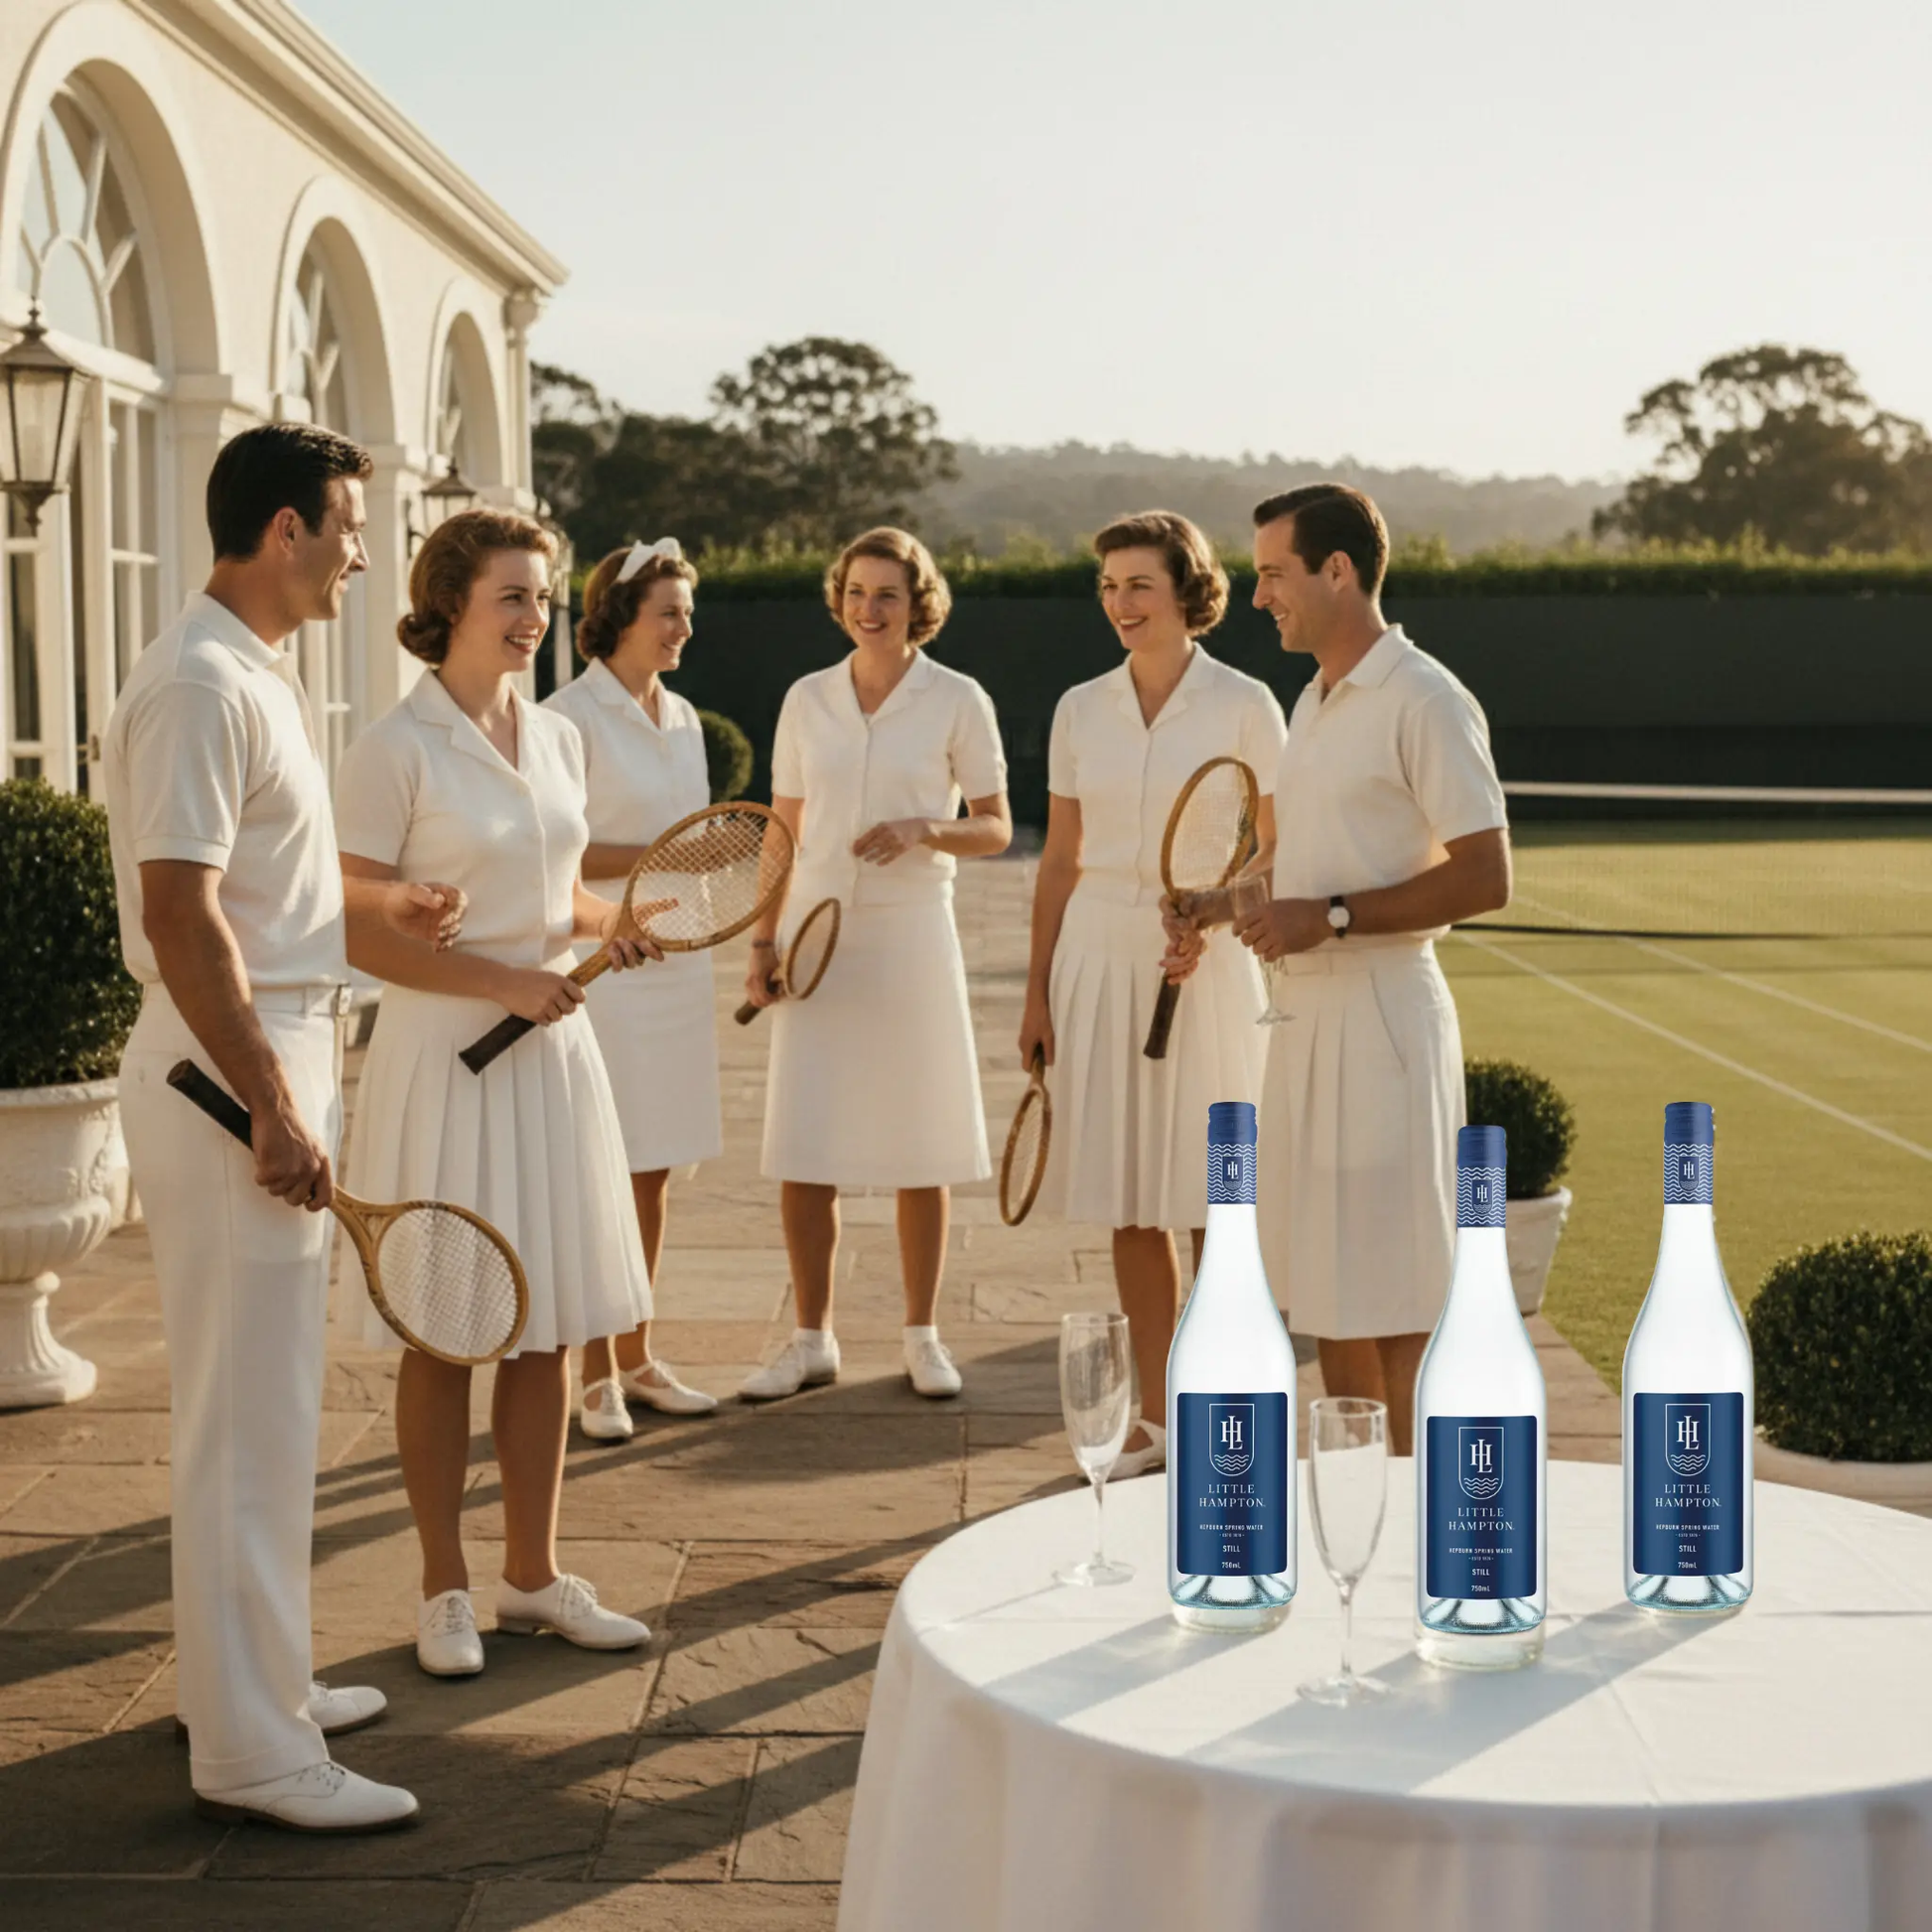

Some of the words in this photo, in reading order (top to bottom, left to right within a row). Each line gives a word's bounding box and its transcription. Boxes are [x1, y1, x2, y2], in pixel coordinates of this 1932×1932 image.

[1208, 1483, 1255, 1494] LITTLE
[1664, 1483, 1711, 1494] LITTLE
[1457, 1506, 1504, 1517] LITTLE
